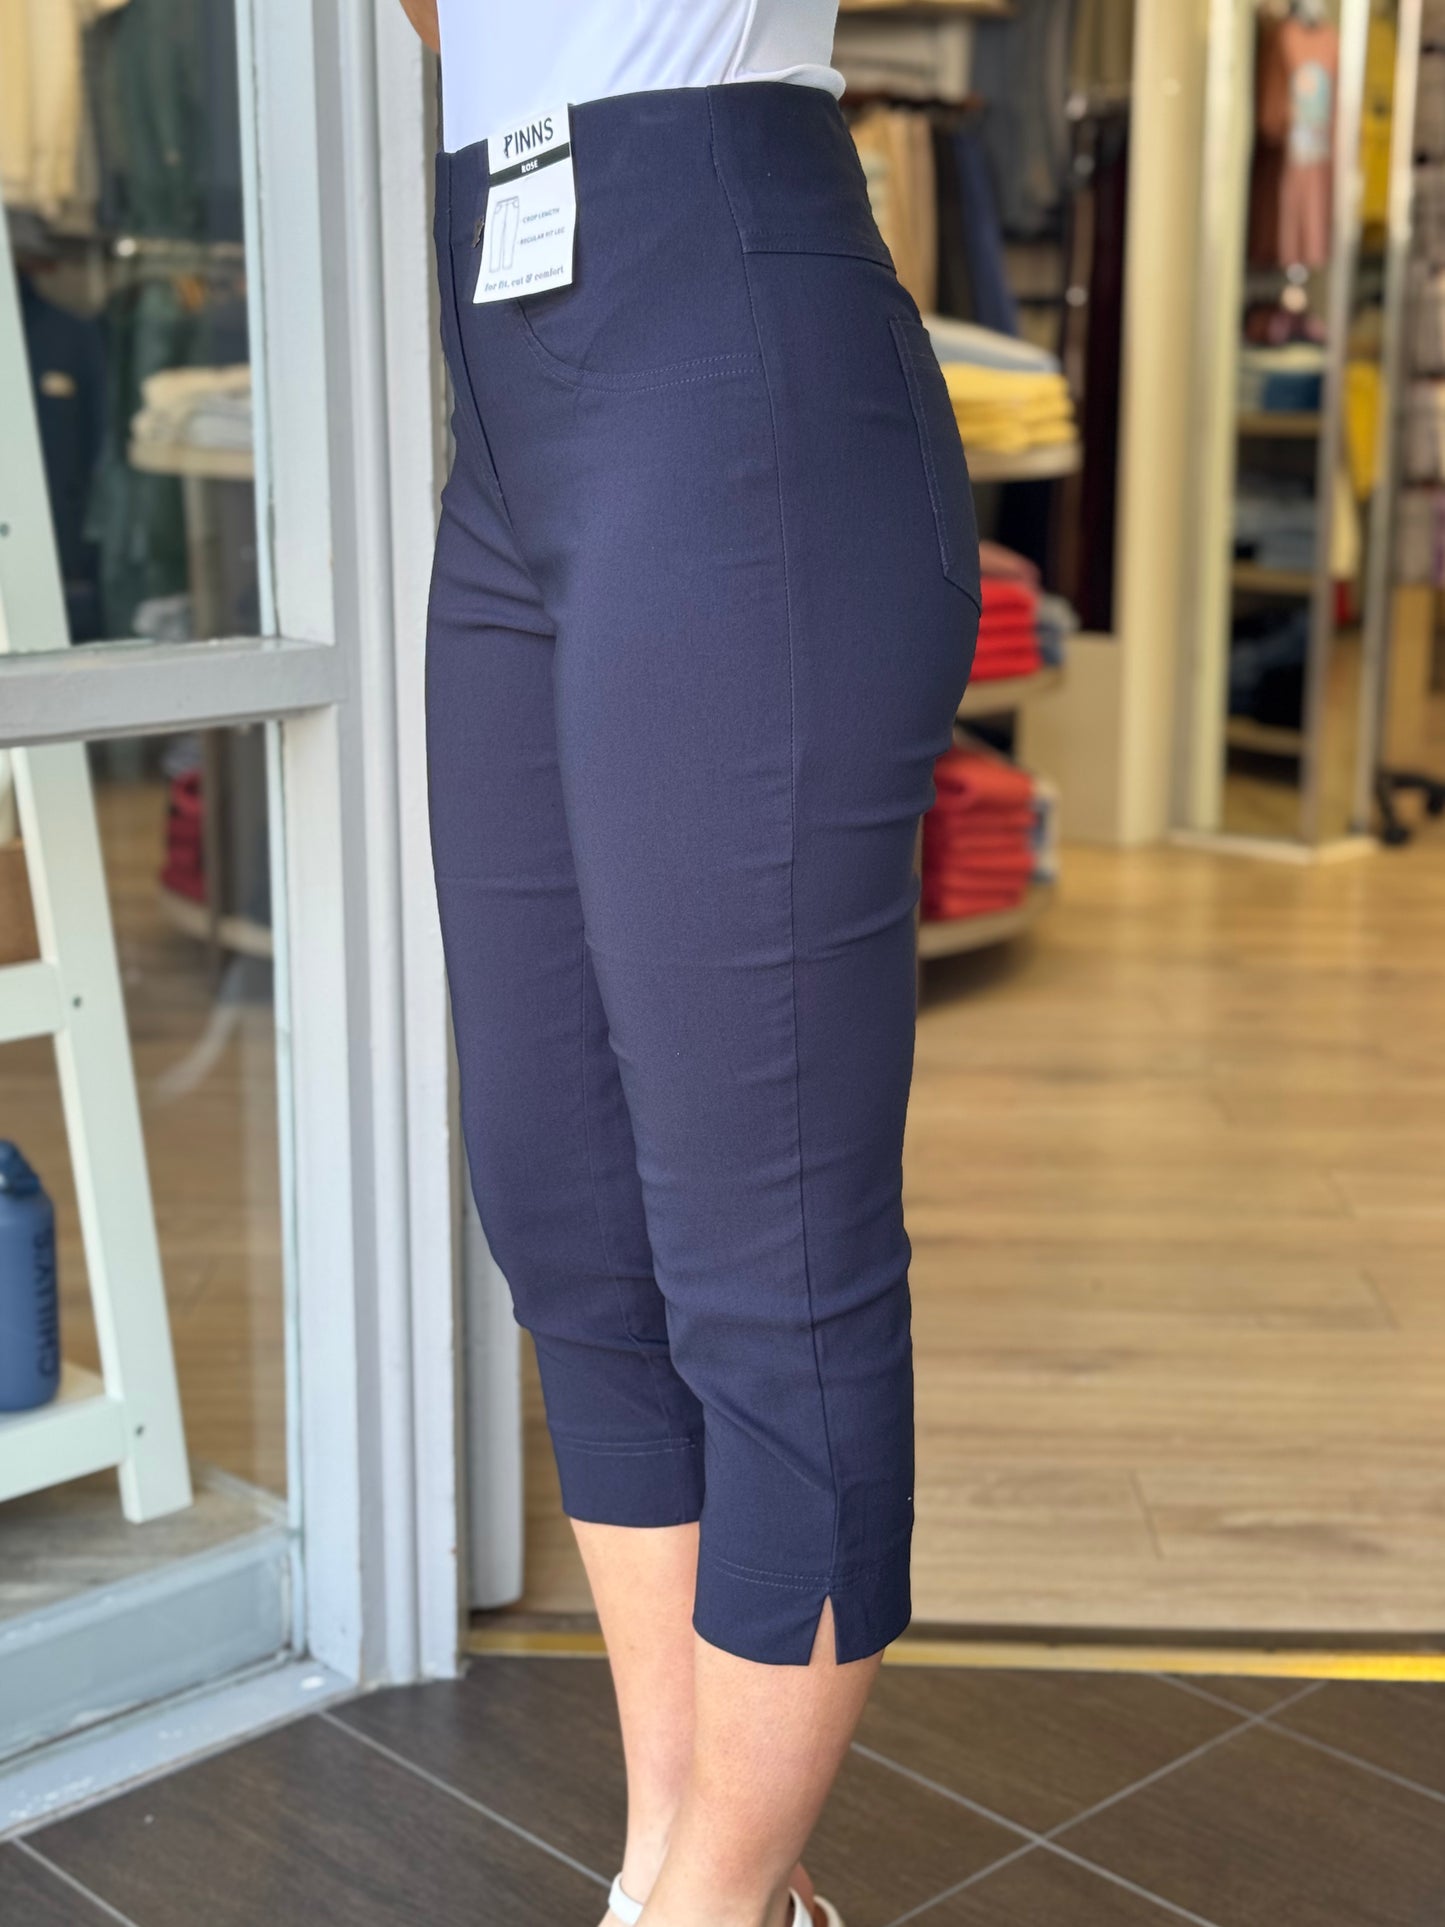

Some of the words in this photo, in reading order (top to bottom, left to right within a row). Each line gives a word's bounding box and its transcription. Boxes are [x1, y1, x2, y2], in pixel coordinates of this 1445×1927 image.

[503, 117, 554, 158] PINNS
[521, 160, 539, 173] ROSE
[522, 213, 538, 224] CROP
[538, 207, 560, 219] LENGTH
[520, 233, 544, 245] REGULAR
[545, 230, 554, 238] FIT
[554, 226, 565, 235] LEG
[484, 282, 497, 292] for
[511, 276, 524, 287] cut
[534, 265, 564, 281] comfort
